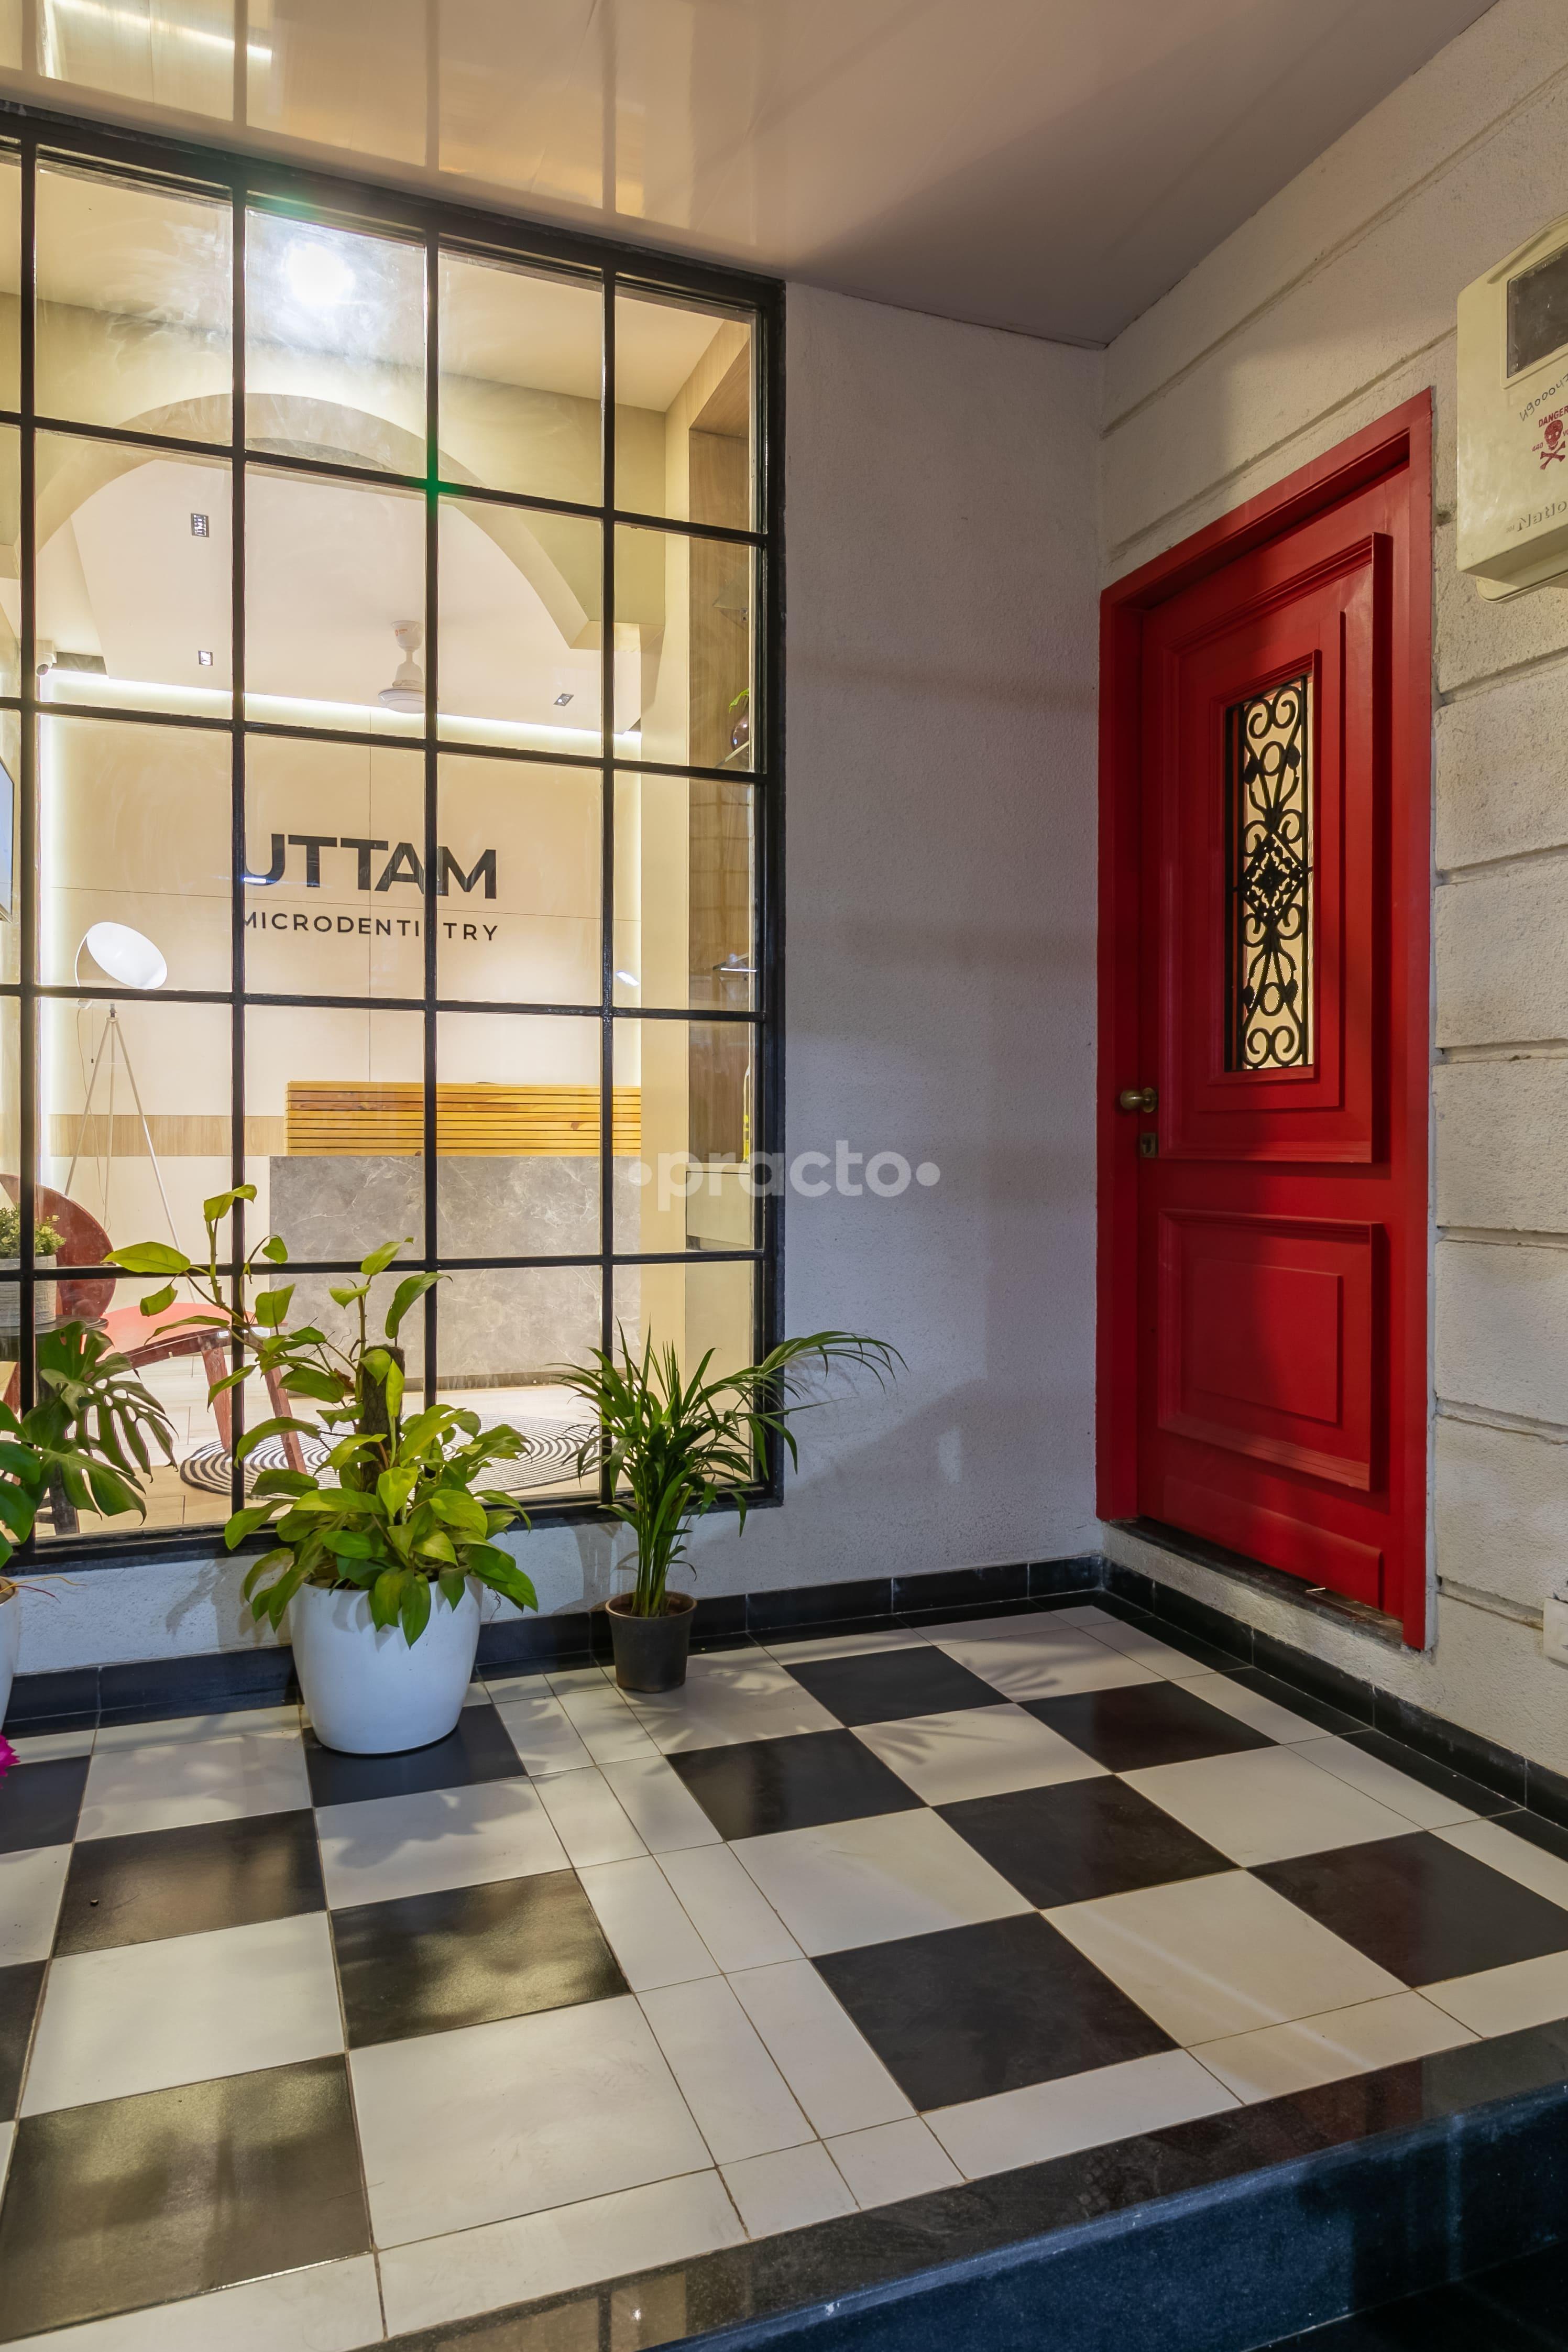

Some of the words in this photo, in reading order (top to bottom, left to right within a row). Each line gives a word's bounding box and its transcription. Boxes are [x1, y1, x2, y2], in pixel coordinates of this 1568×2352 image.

[1538, 405, 1568, 428] DANGER
[244, 833, 497, 899] UTTAM
[244, 911, 498, 941] MICRODENTITRY
